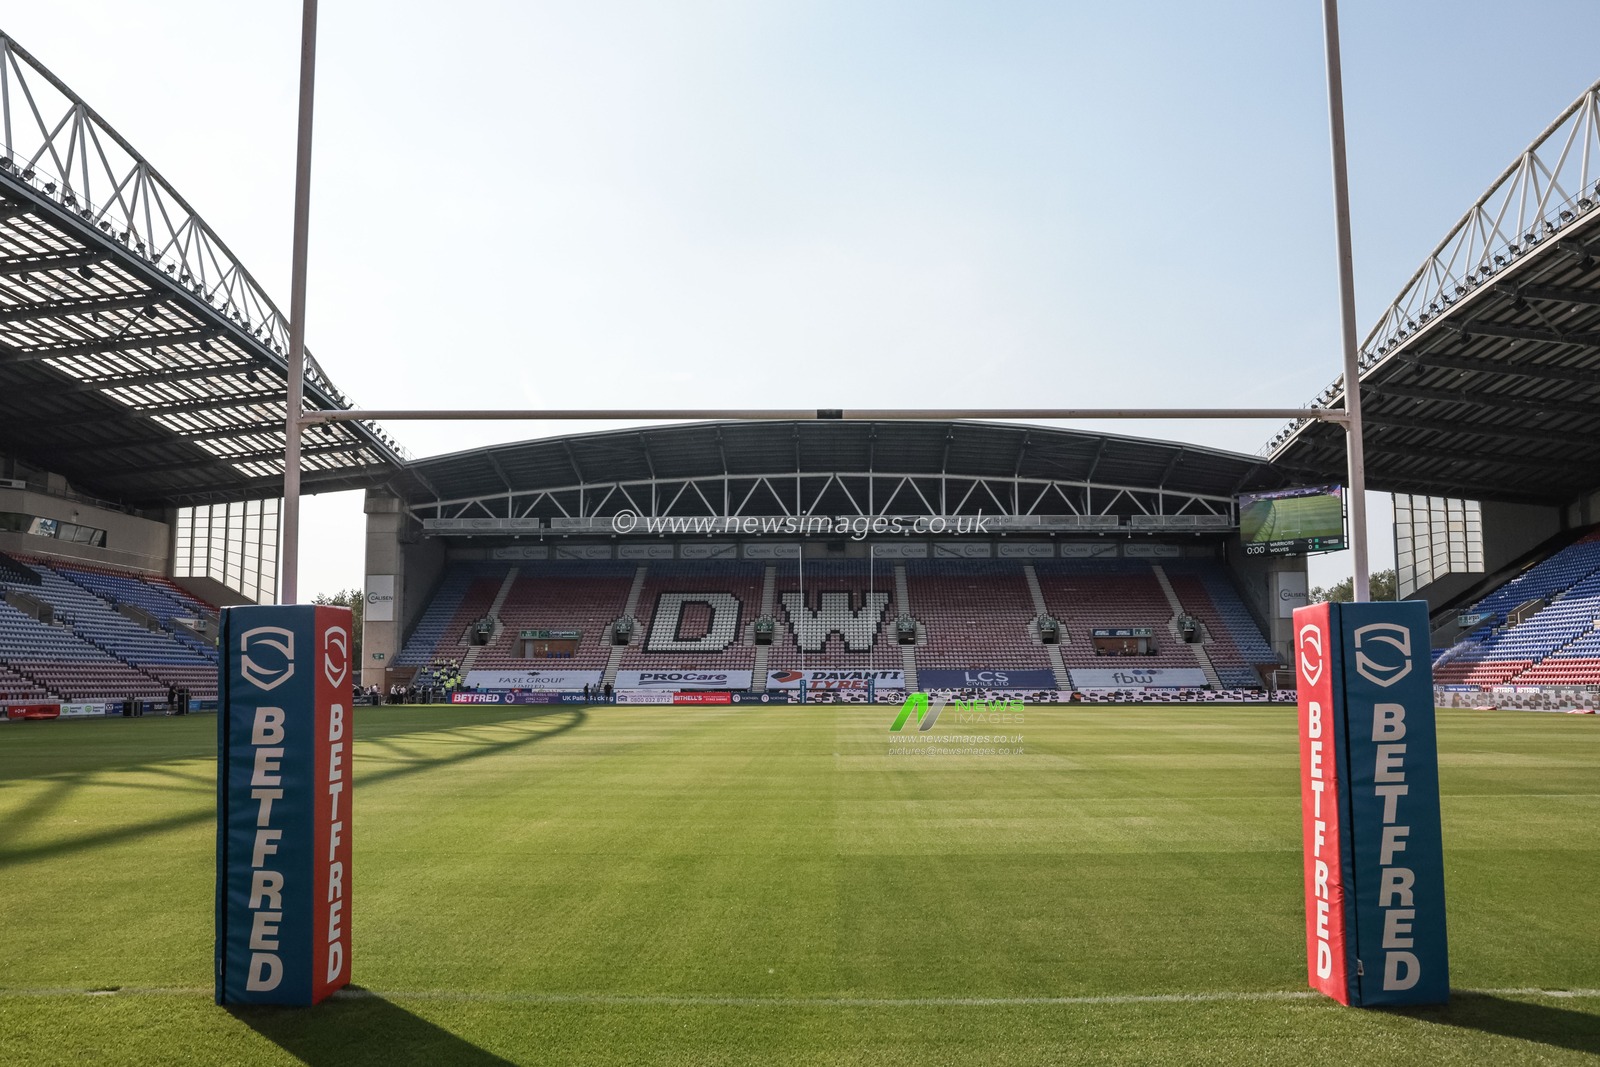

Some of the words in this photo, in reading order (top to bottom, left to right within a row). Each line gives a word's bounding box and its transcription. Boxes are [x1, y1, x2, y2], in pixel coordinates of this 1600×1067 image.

[1246, 546, 1265, 554] 0:00
[812, 672, 900, 680] DAVANTI
[964, 672, 1008, 682] LCS
[1112, 672, 1154, 684] fbw
[453, 694, 500, 702] BETFRED
[326, 703, 344, 984] BETFRED
[1308, 701, 1332, 980] BETFRED
[246, 706, 286, 992] BETFRED
[1372, 703, 1421, 992] BETFRED
